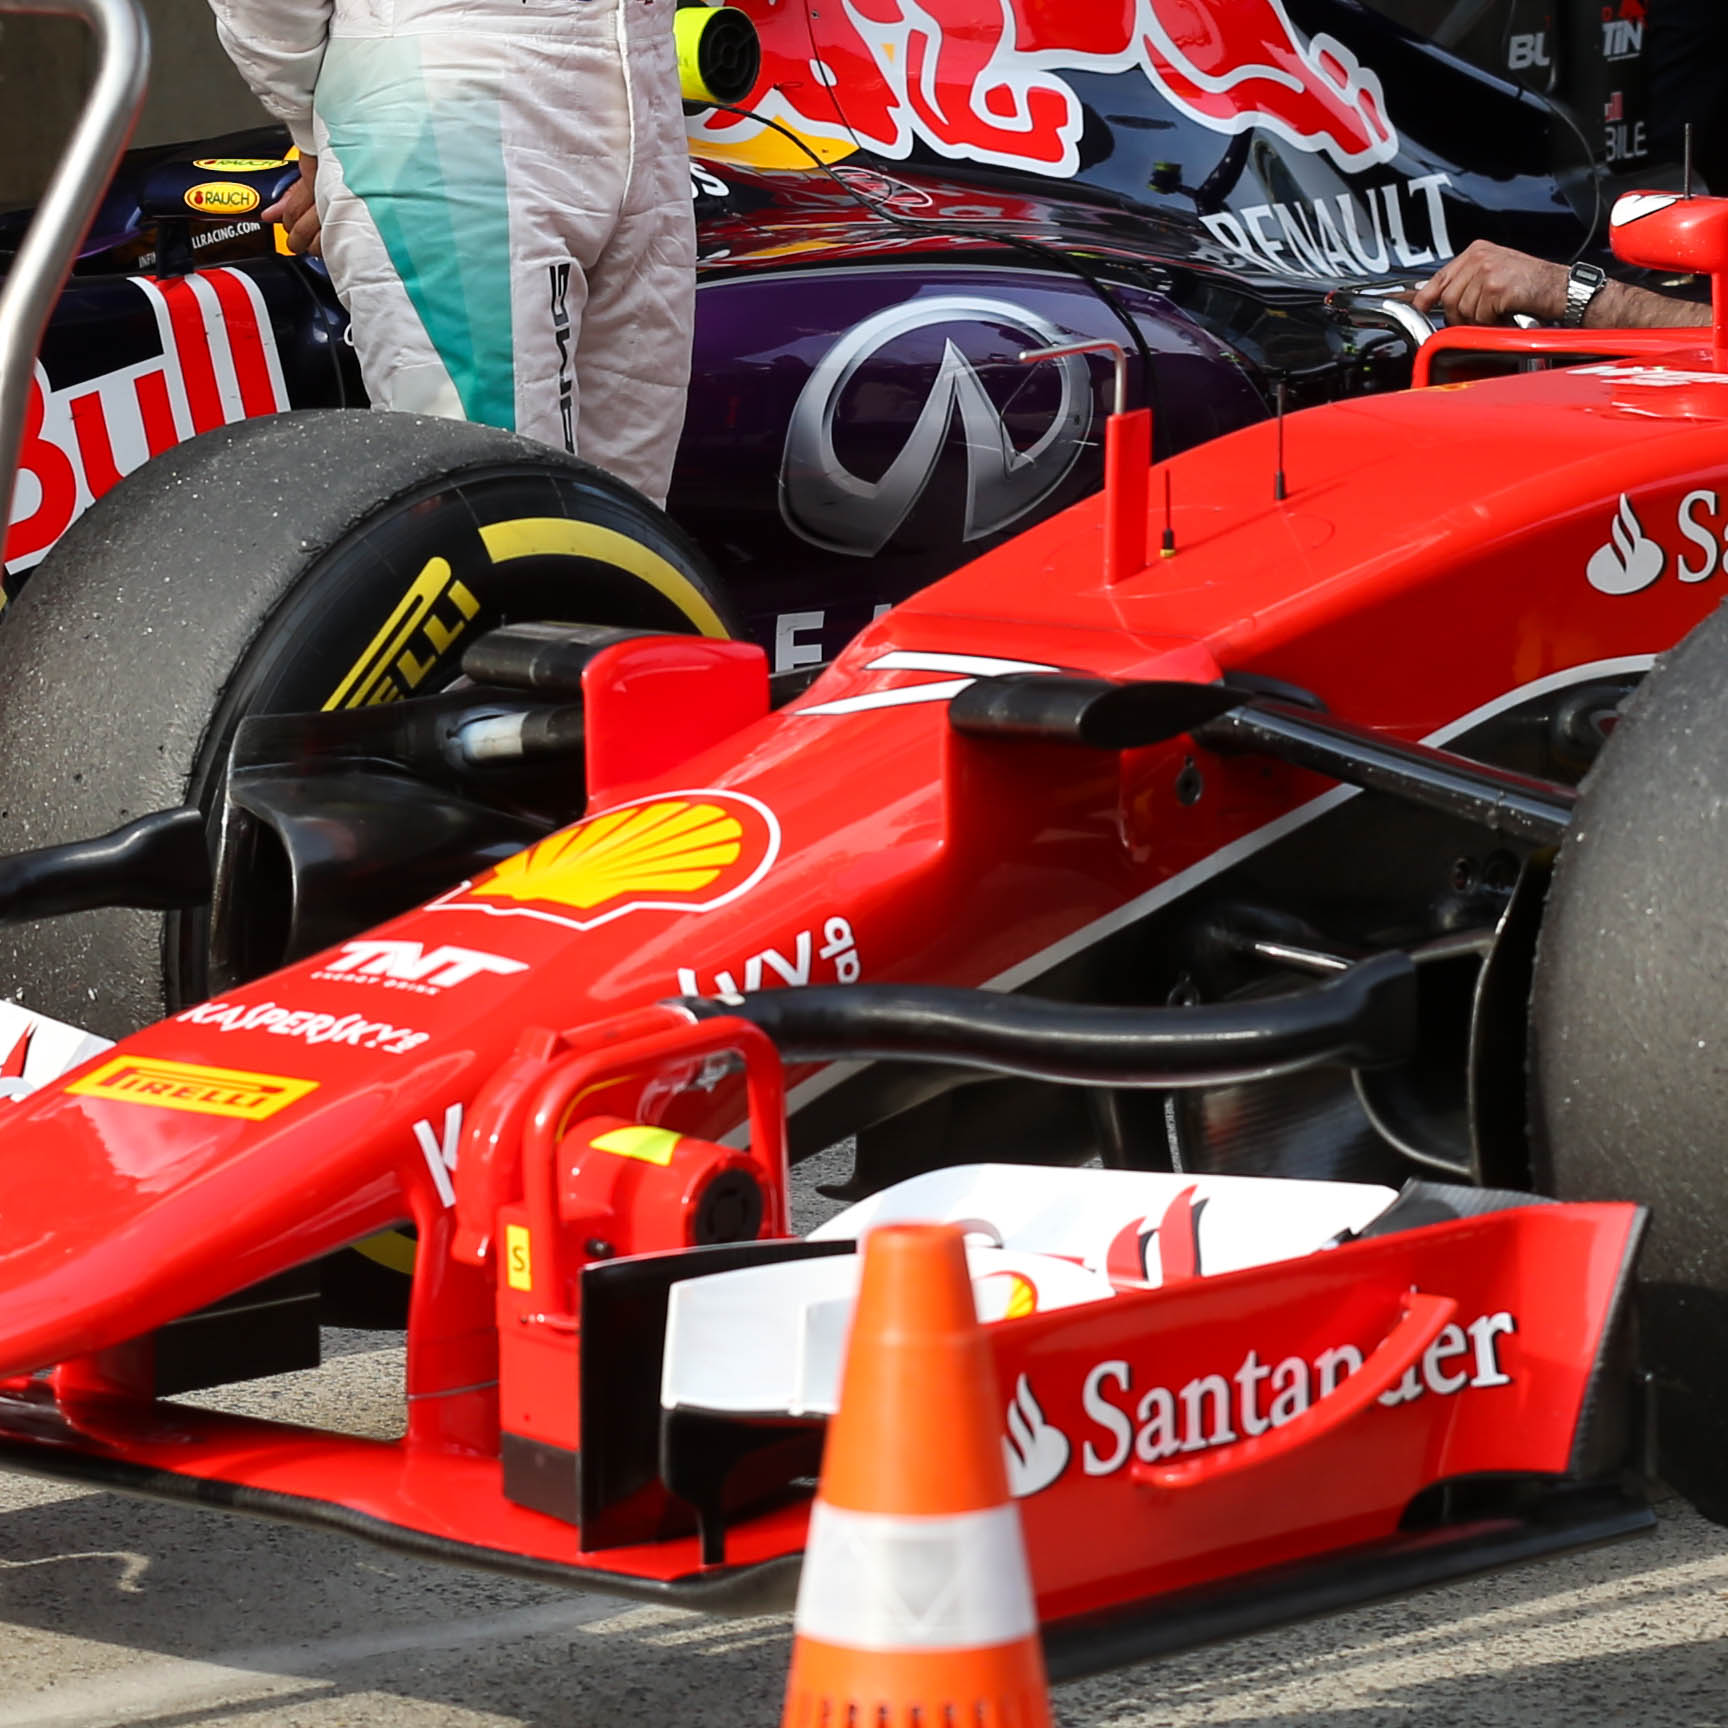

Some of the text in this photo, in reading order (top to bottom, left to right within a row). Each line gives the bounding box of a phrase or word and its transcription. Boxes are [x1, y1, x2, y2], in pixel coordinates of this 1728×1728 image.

[204, 190, 251, 206] RAUCH
[1198, 173, 1455, 278] RENAULT
[321, 939, 530, 988] TNT
[176, 1001, 408, 1048] KASPERSKY
[100, 1066, 288, 1109] PIRELLI
